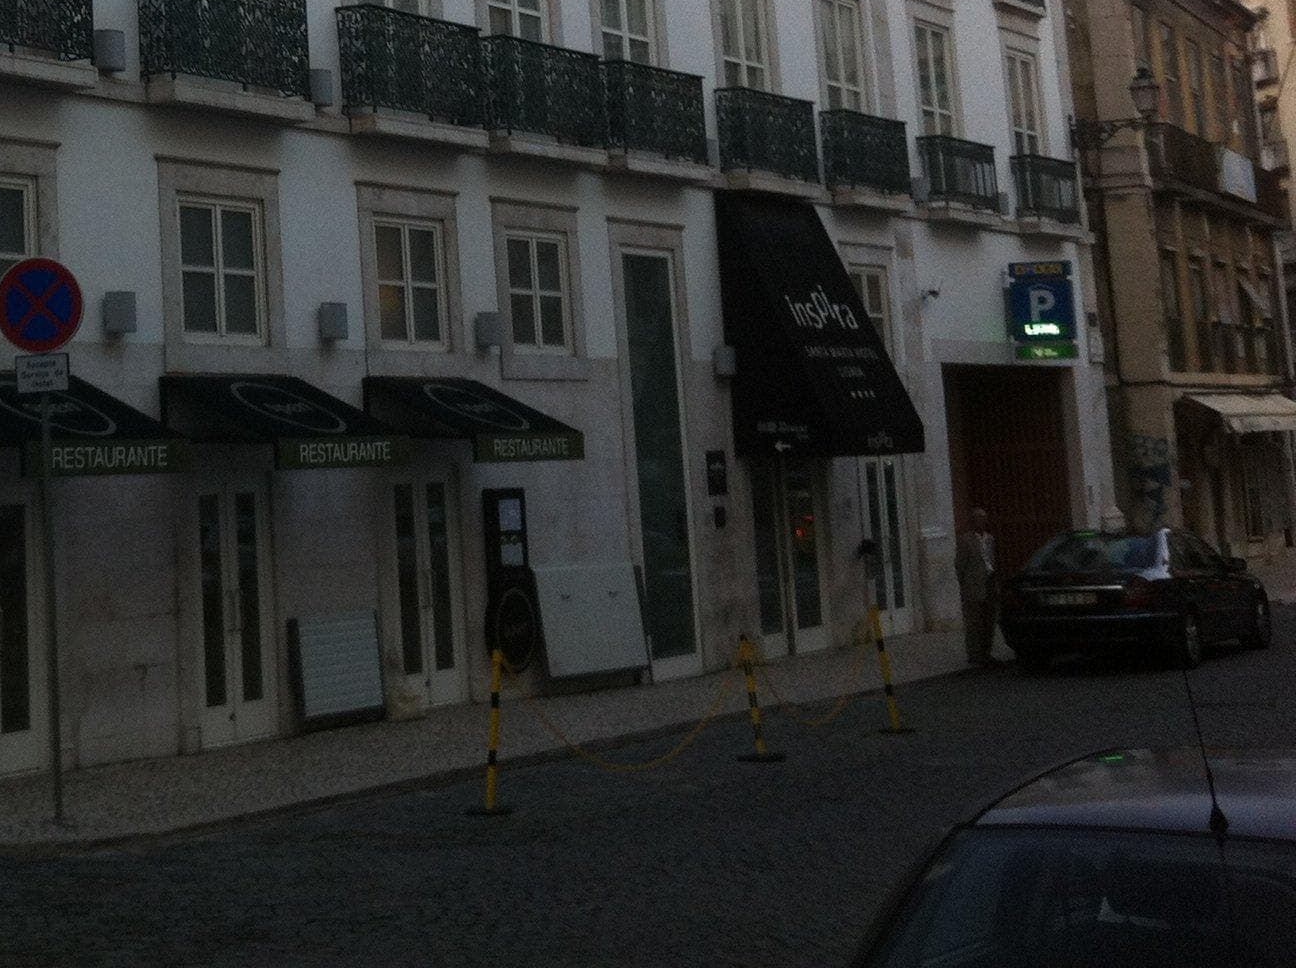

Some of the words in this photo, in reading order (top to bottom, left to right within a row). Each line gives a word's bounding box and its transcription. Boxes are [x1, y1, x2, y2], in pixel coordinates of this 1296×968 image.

[1028, 288, 1056, 322] P
[51, 445, 168, 469] RESTAURANTE
[299, 441, 392, 463] RESTAURANTE
[493, 437, 570, 458] RESTAURANTE
